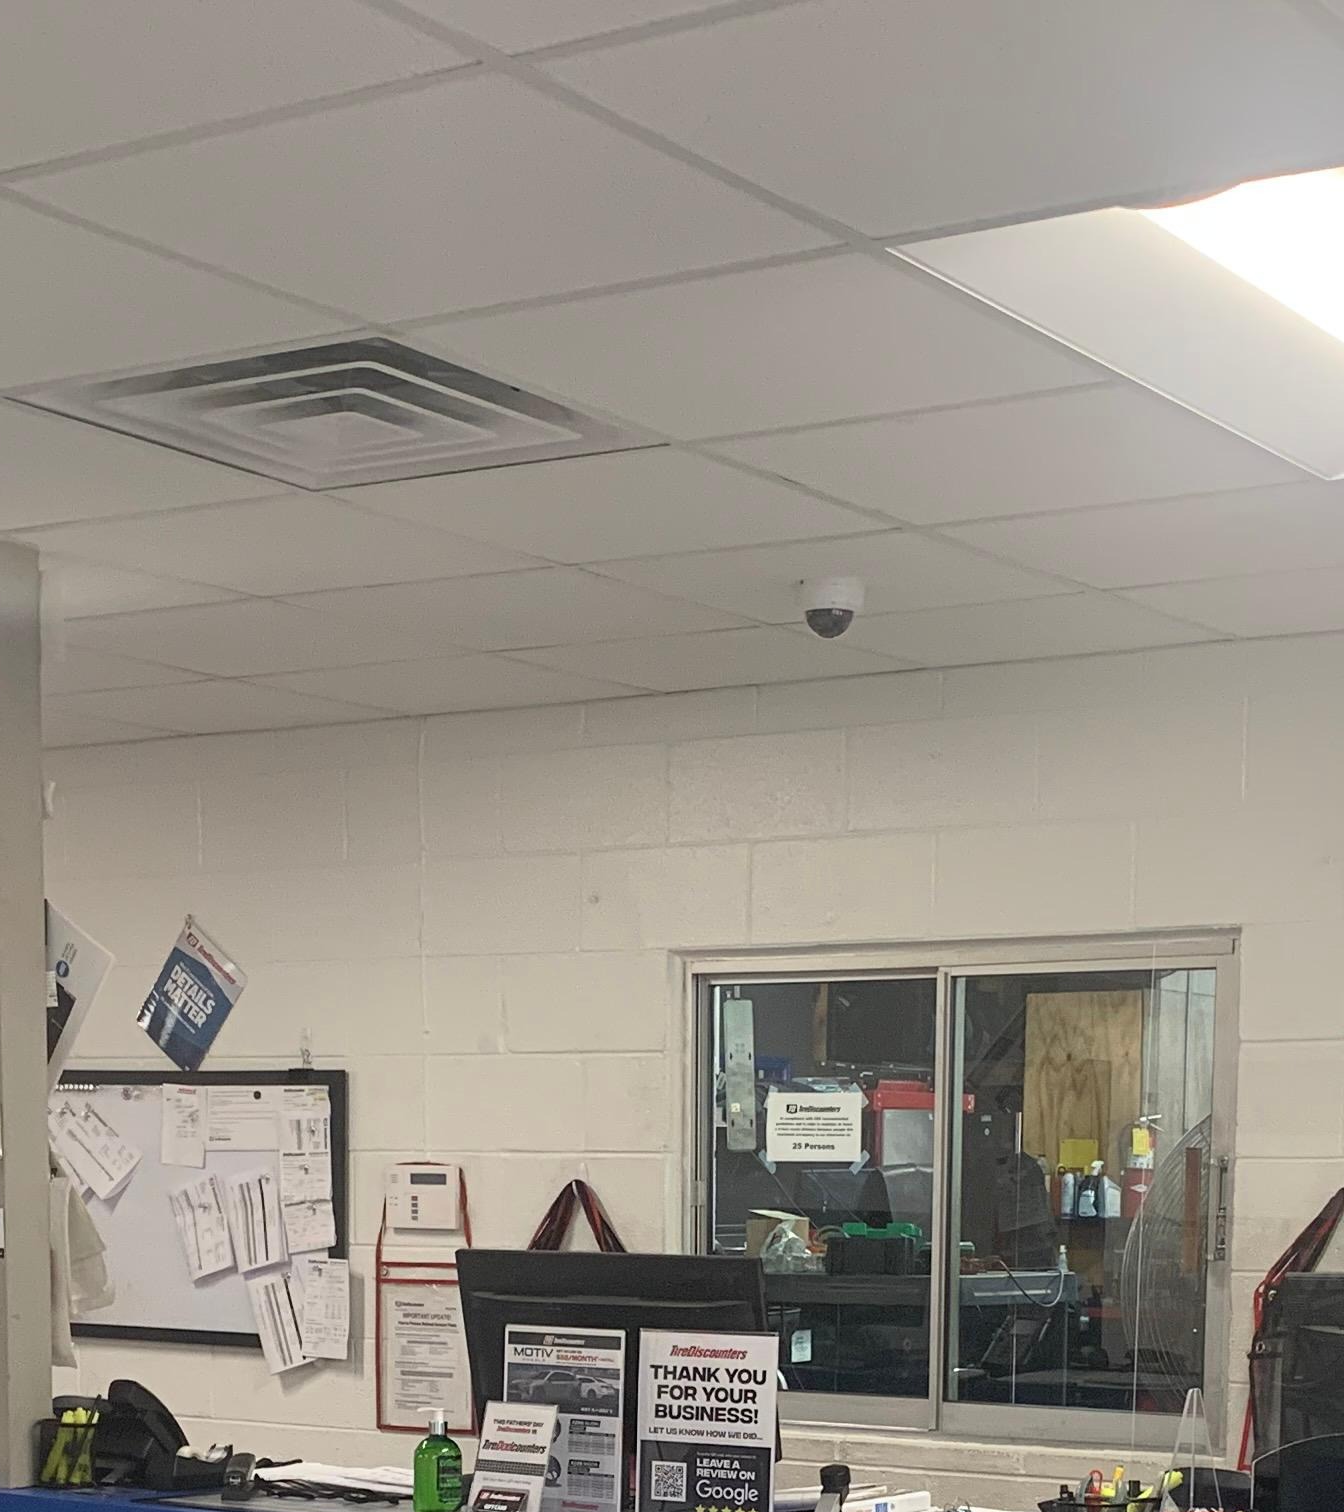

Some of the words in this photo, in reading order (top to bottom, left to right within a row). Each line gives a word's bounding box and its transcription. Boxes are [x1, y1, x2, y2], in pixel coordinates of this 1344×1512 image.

[168, 963, 216, 1015] DETAILS
[163, 978, 208, 1028] MATTER
[792, 1142, 803, 1150] 25
[805, 1142, 835, 1150] Persons
[513, 1347, 554, 1358] MOTIV
[669, 1345, 748, 1360] TireDiscounters
[650, 1364, 720, 1383] THANK
[724, 1367, 767, 1385] YOU
[657, 1384, 697, 1401] FOR
[701, 1386, 757, 1404] YOUR
[654, 1404, 759, 1425] BUSINESS!
[666, 1427, 678, 1435] US
[678, 1428, 705, 1437] KNOW
[705, 1430, 727, 1438] HOW
[727, 1431, 742, 1439] WE
[696, 1458, 730, 1468] LEAVE
[731, 1460, 740, 1469] A
[696, 1468, 737, 1479] REVIEW
[738, 1471, 756, 1481] ON
[696, 1479, 759, 1505] Google
